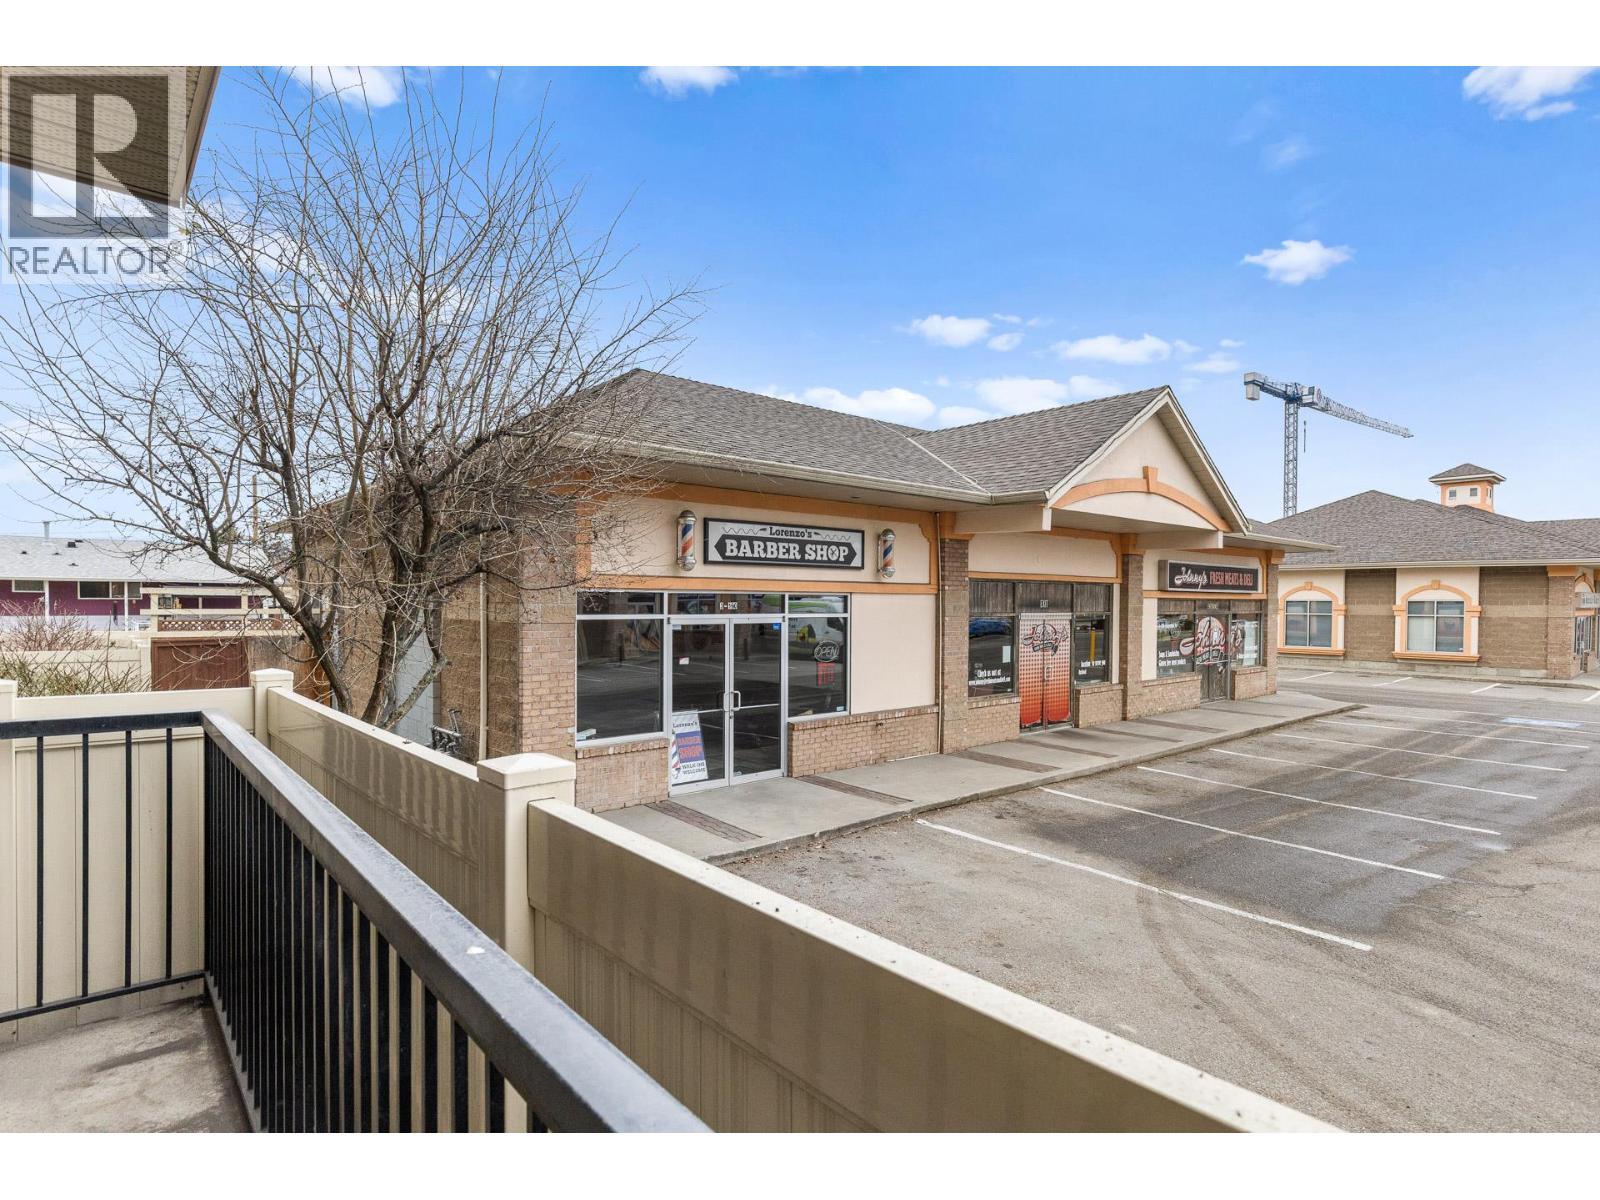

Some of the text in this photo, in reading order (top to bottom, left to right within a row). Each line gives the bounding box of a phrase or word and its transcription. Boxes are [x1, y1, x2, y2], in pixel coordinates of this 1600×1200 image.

[769, 526, 813, 538] Lorenzo's
[725, 539, 849, 562] BARBER SHOP
[1174, 566, 1208, 590] Johnny's
[1210, 571, 1224, 585] FRESH
[1225, 572, 1239, 586] MEATS
[1244, 573, 1254, 586] DELI
[816, 645, 838, 658] OPEN
